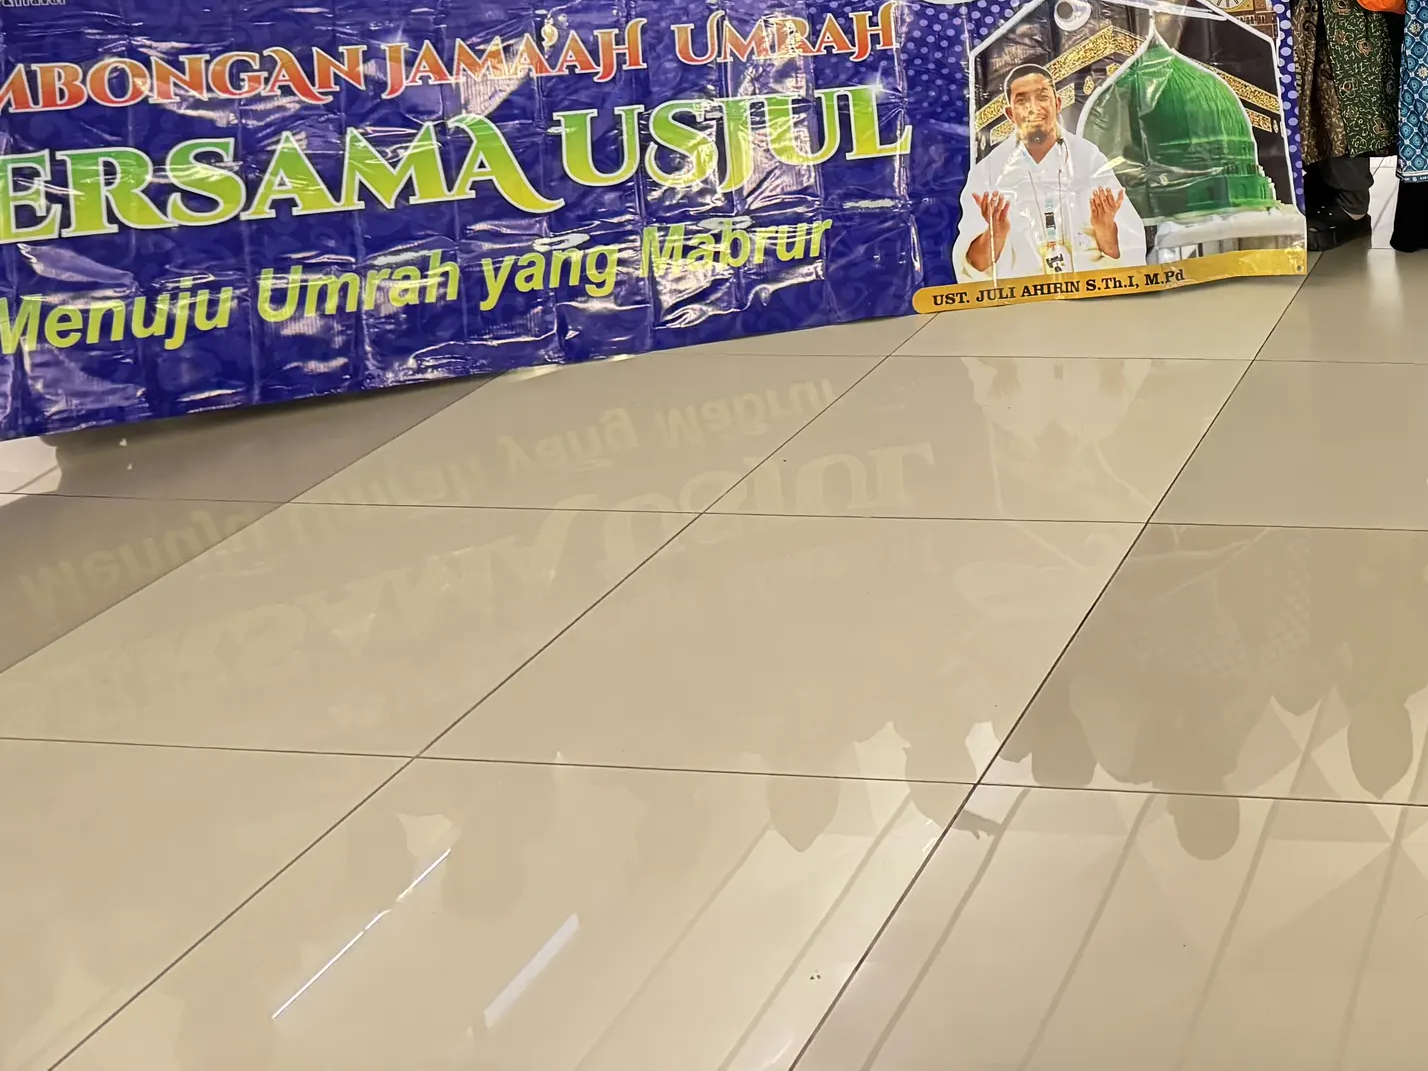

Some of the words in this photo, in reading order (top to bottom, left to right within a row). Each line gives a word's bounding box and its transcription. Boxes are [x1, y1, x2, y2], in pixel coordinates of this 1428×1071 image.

[382, 16, 649, 99] JAMA'AH
[671, 0, 899, 68] UMRAH
[0, 111, 565, 244] ERSAMA
[553, 84, 913, 195] USJUL
[0, 280, 233, 355] Menuju
[255, 249, 459, 323] Umrah
[479, 241, 619, 311] yang
[640, 219, 833, 281] Mabrur
[932, 292, 970, 306] UST.
[976, 287, 1016, 302] JULI
[1021, 281, 1081, 298] AHIRIN
[1085, 276, 1139, 292] S.Th.I,
[1144, 269, 1185, 286] M.Pd
